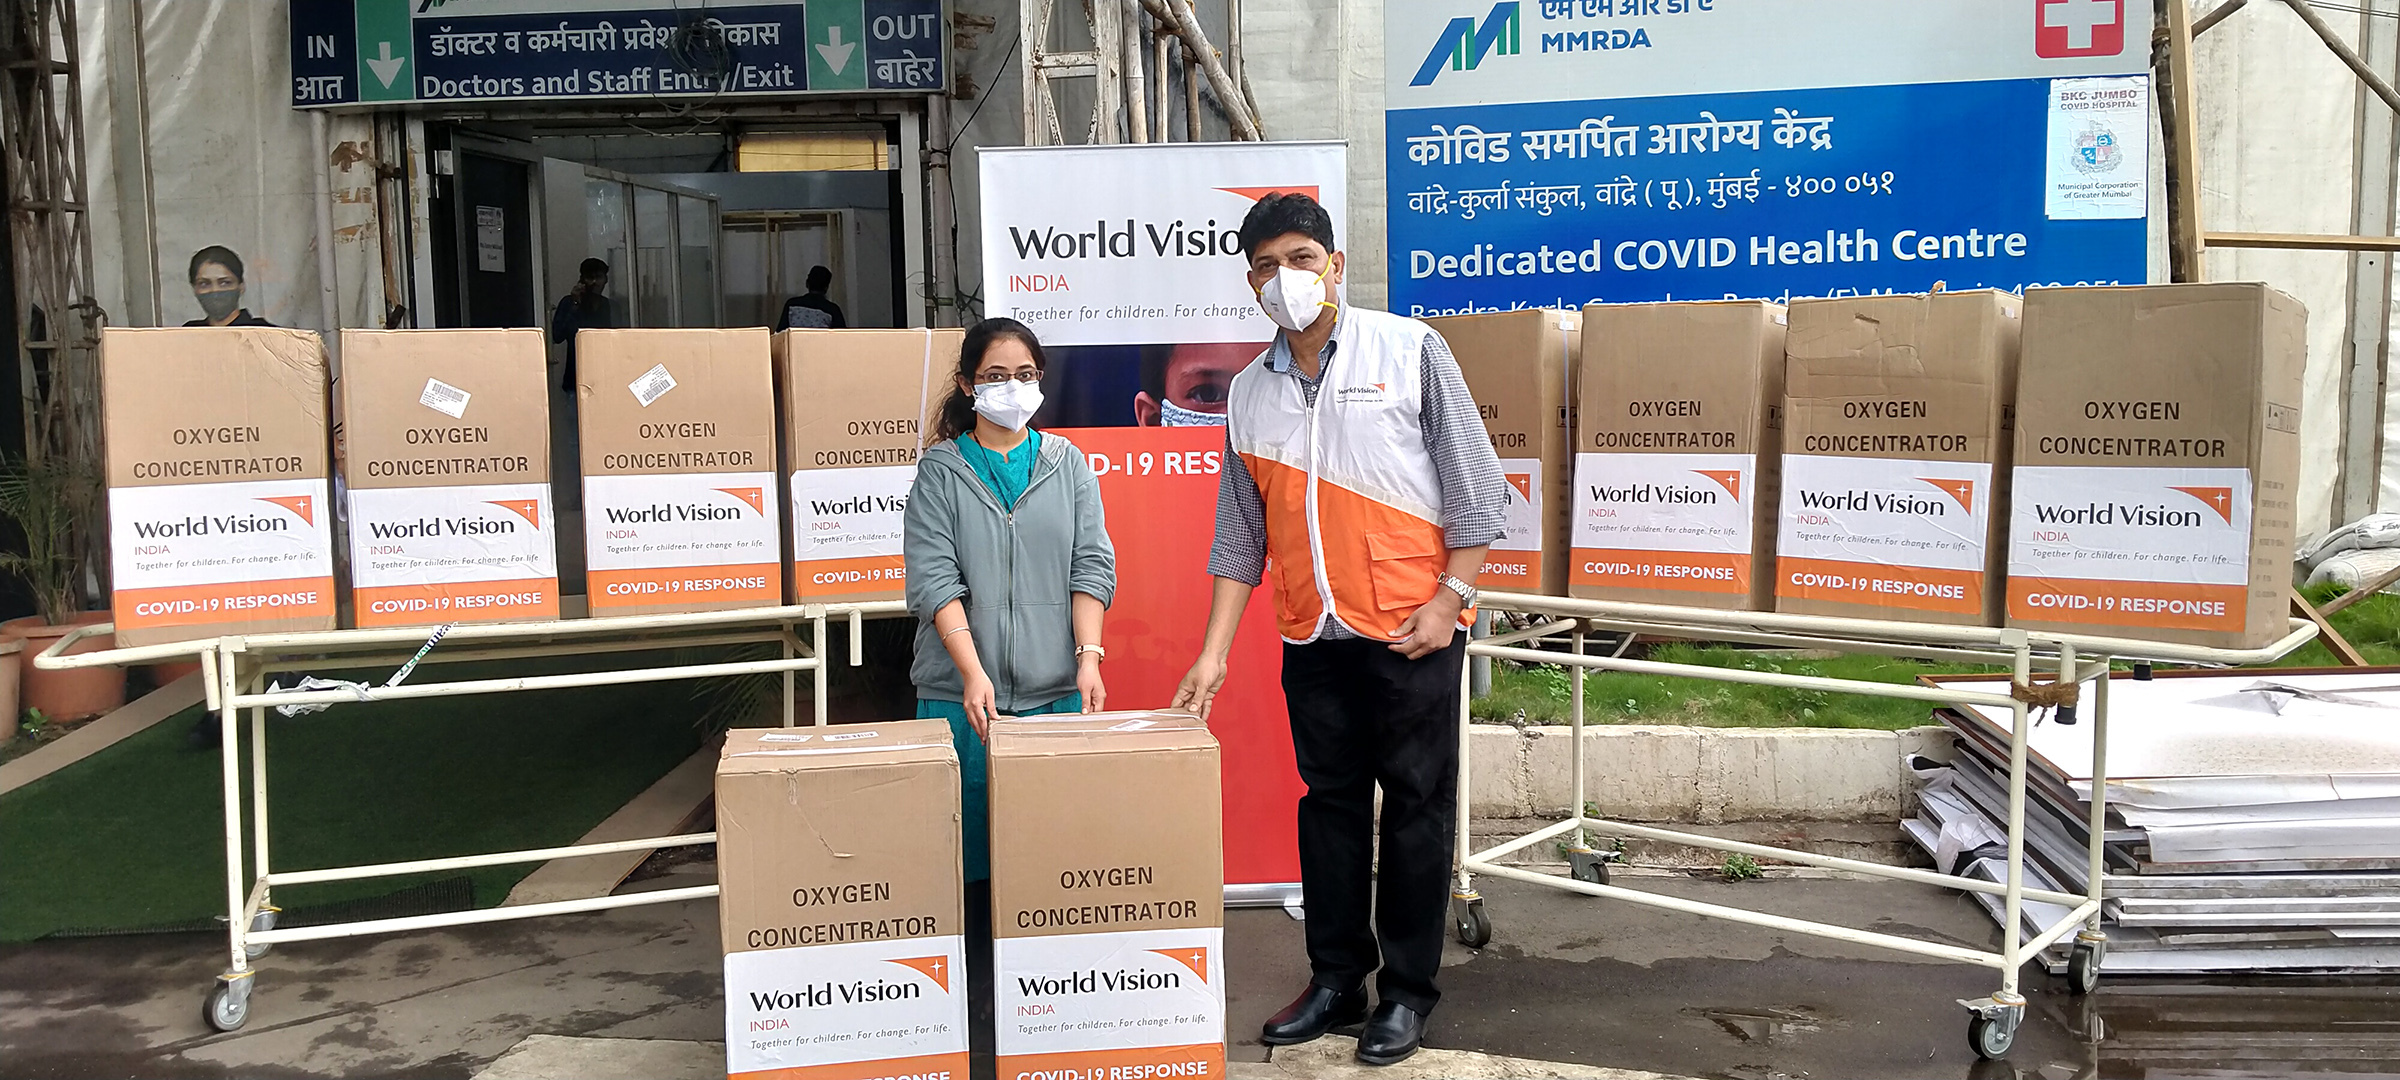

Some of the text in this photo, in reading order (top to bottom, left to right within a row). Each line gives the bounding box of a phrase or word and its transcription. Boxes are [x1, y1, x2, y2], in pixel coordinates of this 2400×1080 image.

[872, 14, 935, 40] OUT
[307, 35, 335, 58] IN
[430, 26, 498, 57] डॉक्टर
[503, 31, 521, 53] व
[526, 21, 617, 53] कर्मचारी
[1542, 28, 1652, 53] MMRDA
[874, 50, 936, 87] बाहेर
[295, 76, 343, 100] आत
[423, 75, 524, 98] Doctors
[532, 69, 579, 94] and
[588, 67, 652, 91] Staff
[2061, 90, 2137, 101] BKC JUMBO
[2061, 101, 2137, 110] COVID HOSPITAL
[1406, 108, 1834, 165] कोविड समर्पित आरोग्य केंद्र
[1407, 180, 1510, 220] वांद्रे-कुर्ला
[1594, 175, 1638, 207] वांद्रे
[1707, 168, 1762, 209] मुंबई
[1785, 175, 1837, 198] ४००
[2058, 182, 2093, 190] Municipal
[2102, 190, 2132, 198] Mumbai
[1009, 219, 1244, 259] World Visio
[1411, 228, 2027, 278] Dedicated COVID Health Centre
[1010, 275, 1069, 292] INDIA
[1011, 306, 1072, 324] Together
[1079, 305, 1100, 321] for
[1106, 303, 1168, 319] children.
[1174, 304, 1197, 318] For
[1203, 301, 1259, 320] change.
[1629, 401, 1701, 417] OXYGEN
[1844, 401, 1926, 418] OXYGEN
[2085, 401, 2180, 420] OXYGEN
[173, 427, 260, 445] OXYGEN
[406, 427, 488, 444] OXYGEN
[639, 422, 716, 439] OXYGEN
[848, 419, 918, 436] OXYGEN
[1595, 432, 1735, 448] CONCENTRATOR
[1805, 435, 1967, 451] CONCENTRATOR
[2040, 437, 2225, 457] CONCENTRATOR
[133, 456, 303, 478] CONCENTRATOR
[368, 456, 529, 476] CONCENTRATOR
[604, 451, 753, 469] CONCENTRATOR
[1082, 451, 1225, 476] D-19 RES
[1591, 485, 1716, 504] World Vision
[1800, 490, 1944, 516] World Vision
[606, 503, 740, 523] World Vision
[811, 494, 908, 516] World Vis
[1588, 508, 1617, 517] INDIA
[2036, 503, 2201, 527] World Vision
[134, 514, 287, 538] World Vision
[370, 517, 514, 539] World Vision
[812, 521, 841, 531] INDIA
[1797, 515, 1830, 525] INDIA
[606, 529, 638, 539] INDIA
[1796, 531, 1968, 551] Together for children. For change. For life.
[2033, 531, 2070, 542] INDIA
[135, 545, 170, 555] INDIA
[370, 545, 404, 555] INDIA
[2032, 549, 2229, 564] Together for children. For change. For life.
[813, 570, 880, 584] COVID-19
[1584, 562, 1734, 580] COVID-19 RESPONSE
[606, 577, 765, 595] COVID-19 RESPONSE
[1791, 573, 1963, 599] COVID-19 RESPONSE
[135, 592, 317, 616] COVID-19 RESPONSE
[371, 592, 542, 613] COVID-19 RESPONSE
[2027, 593, 2225, 616] COVID-19 RESPONSE
[1060, 866, 1152, 889] OXYGEN
[793, 882, 890, 907] OXYGEN
[1017, 900, 1197, 929] CONCENTRATOR
[748, 916, 936, 948] CONCENTRATOR
[1018, 968, 1179, 997] World Vision
[750, 979, 919, 1012] World Vision
[1018, 1003, 1055, 1017] INDIA
[750, 1018, 789, 1032] INDIA
[1018, 1012, 1209, 1035] Together for children. For change. For life.
[751, 1022, 951, 1050] Together for children. For change. For life.
[1110, 1060, 1208, 1080] RESPONSE
